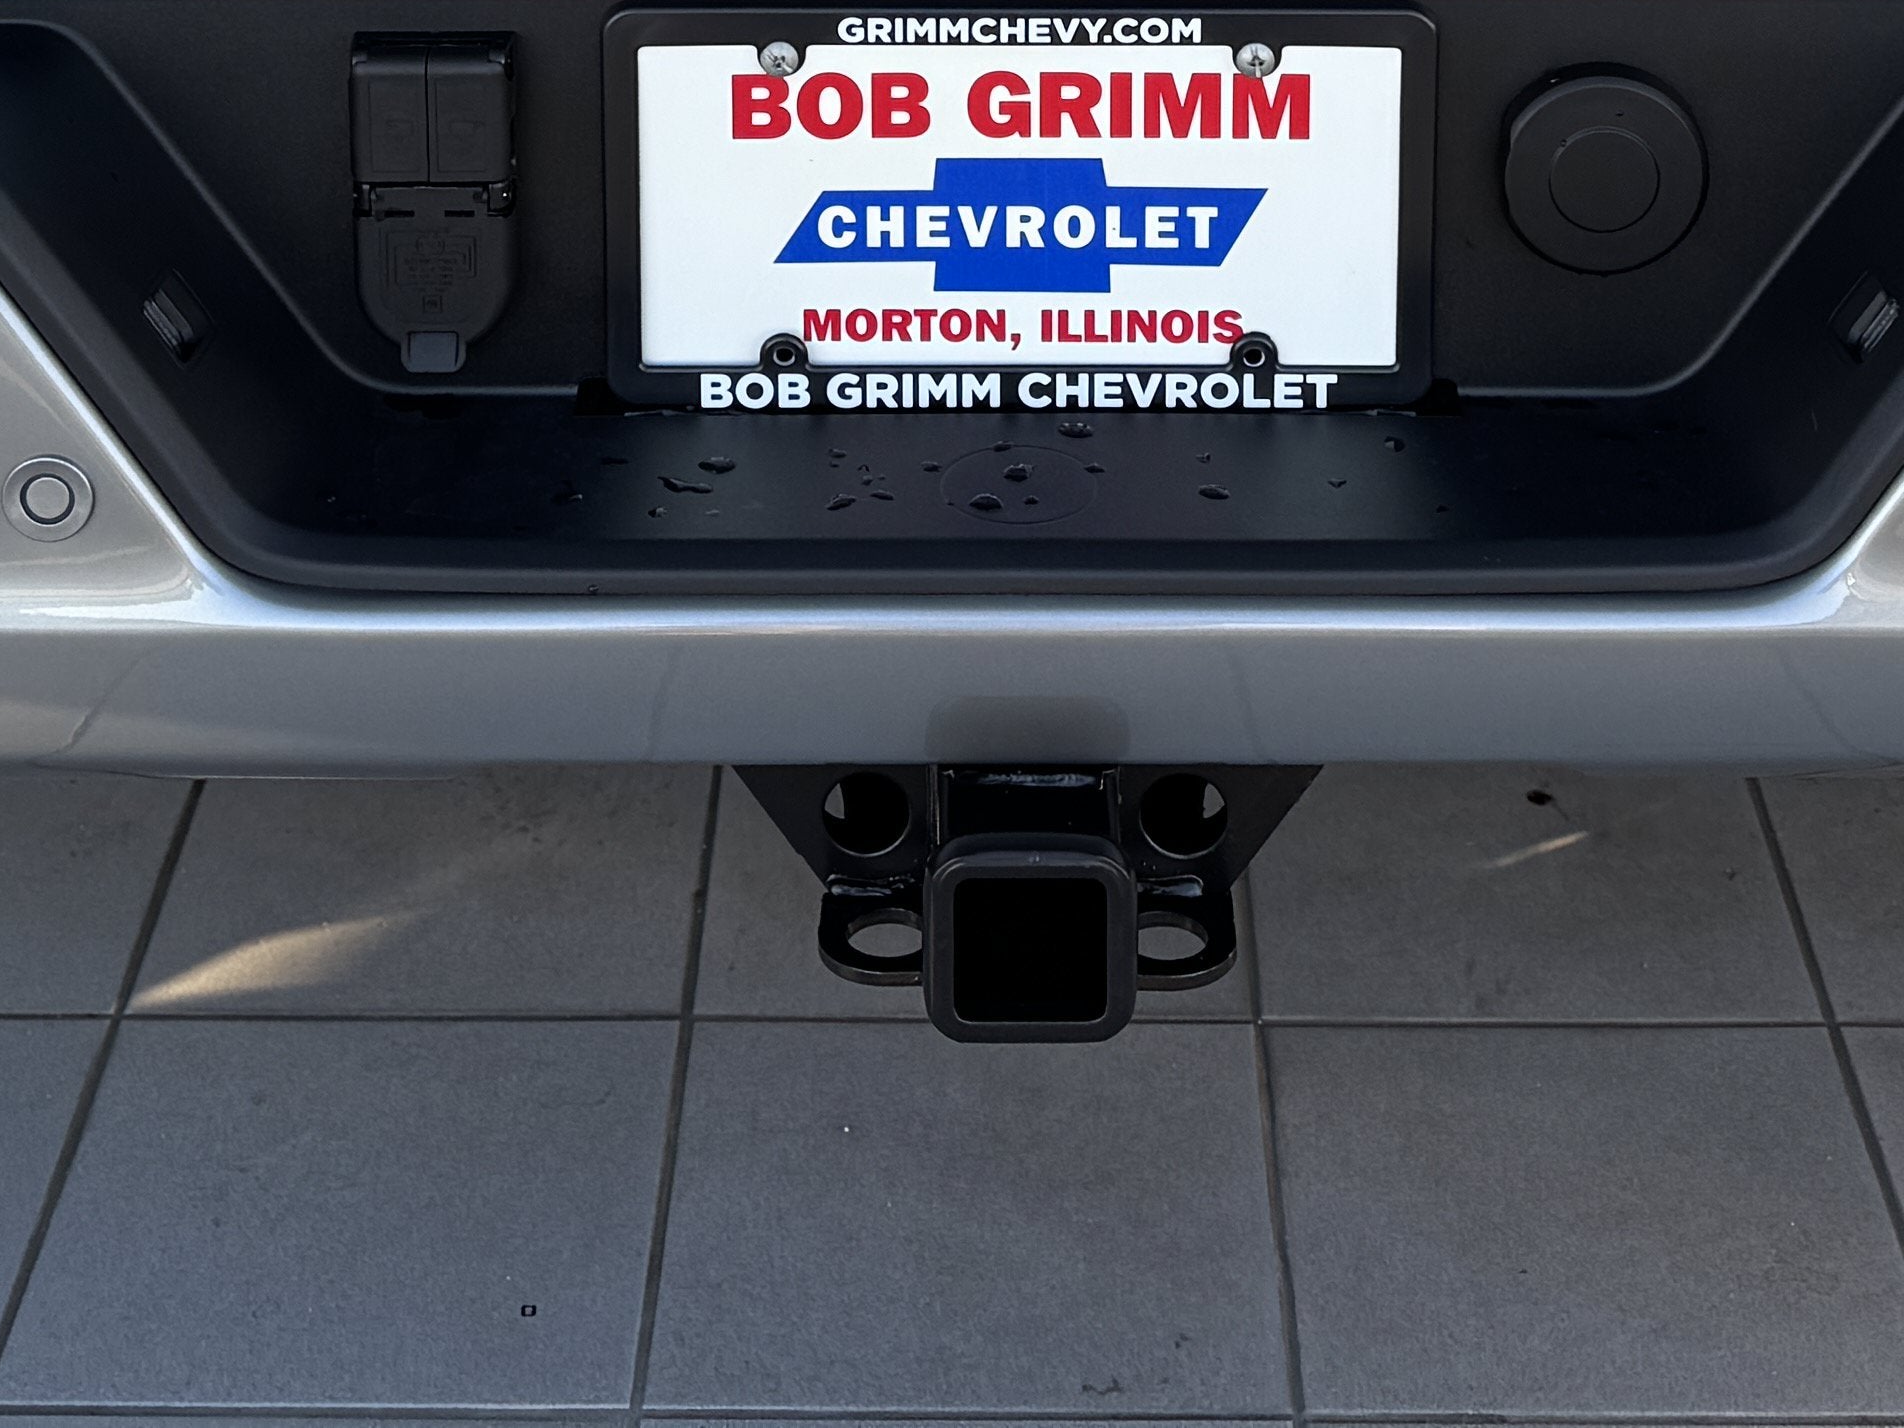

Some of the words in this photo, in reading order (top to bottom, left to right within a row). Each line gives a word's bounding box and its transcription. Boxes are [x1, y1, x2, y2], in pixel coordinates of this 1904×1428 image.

[836, 17, 1203, 46] GRIMMCHEVY.COM
[730, 72, 932, 140] BOB
[967, 70, 1312, 141] GRIMM
[816, 204, 1220, 250] CHEVROLET
[802, 308, 1023, 352] MORTON,
[1039, 308, 1245, 344] ILLINOIS
[699, 372, 812, 411] BOB
[826, 372, 1001, 411] GRIMM
[1018, 372, 1338, 411] CHEVROLET
